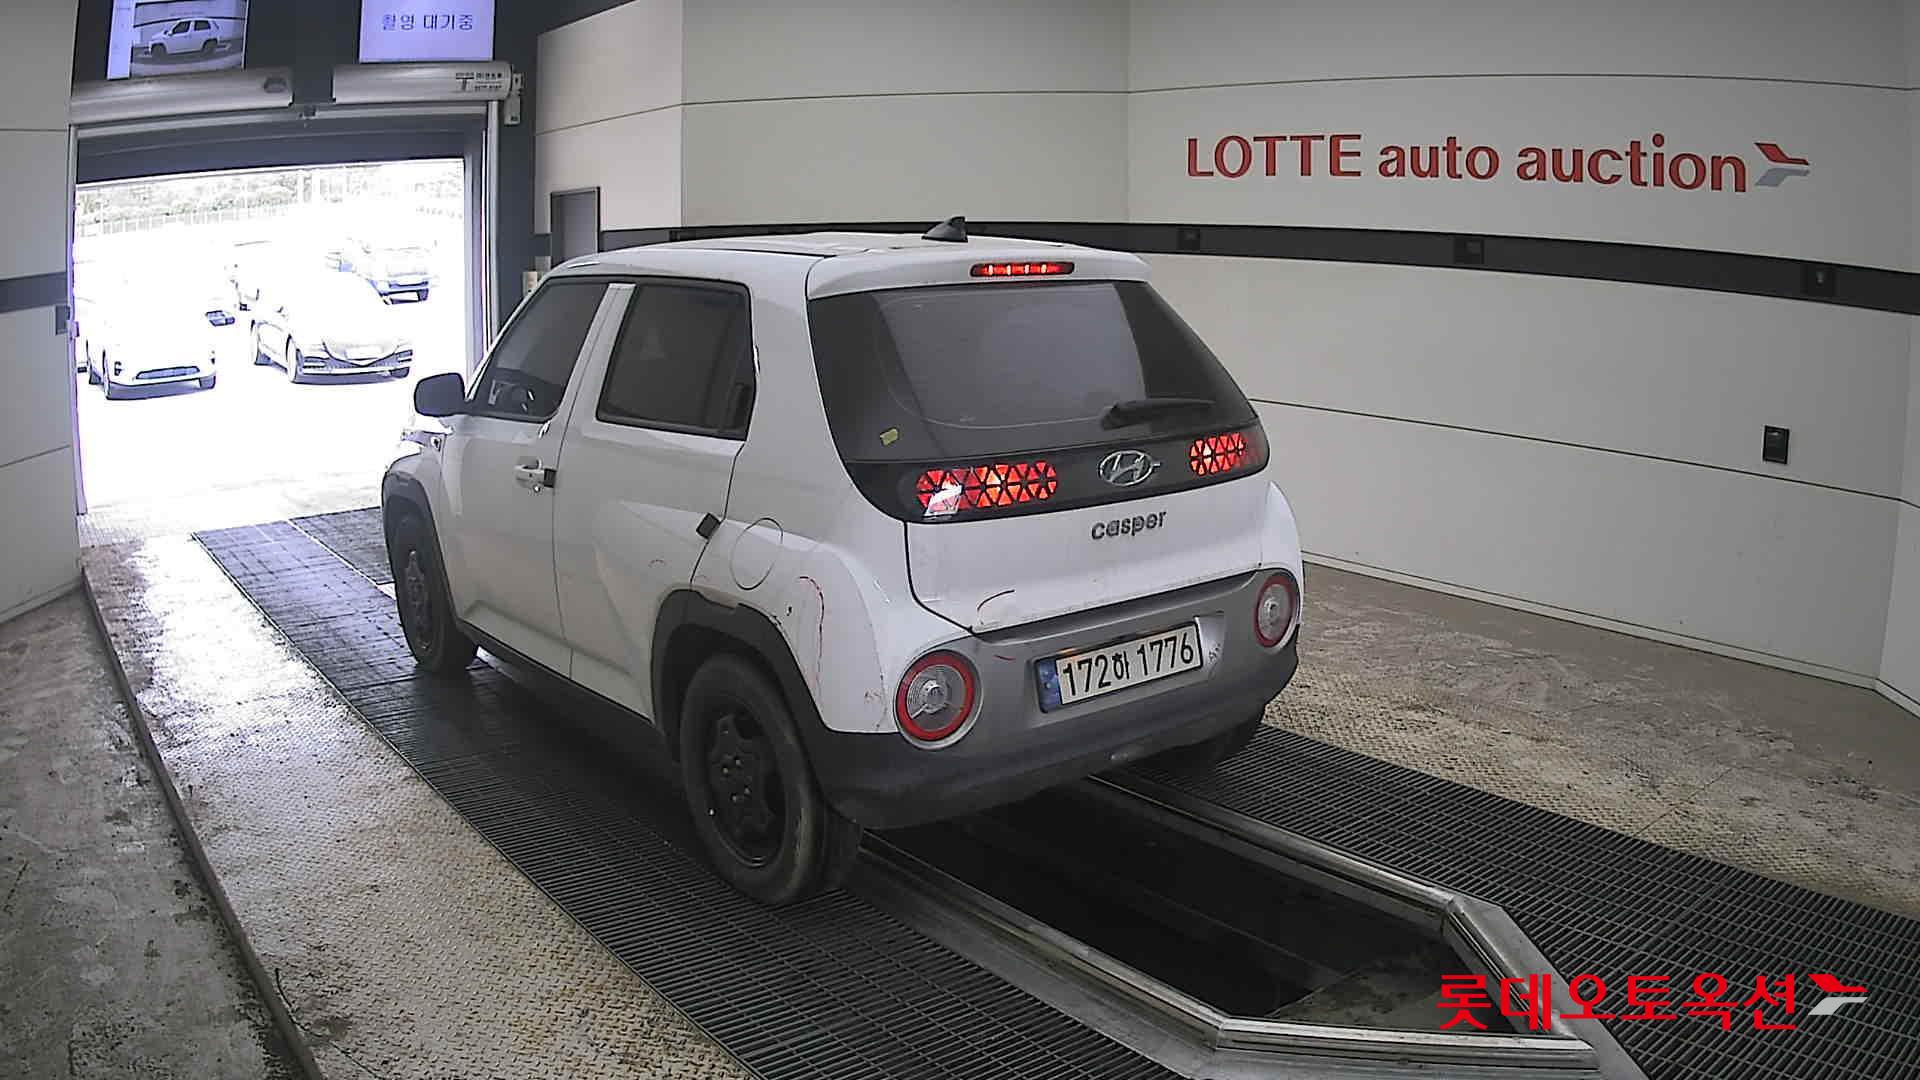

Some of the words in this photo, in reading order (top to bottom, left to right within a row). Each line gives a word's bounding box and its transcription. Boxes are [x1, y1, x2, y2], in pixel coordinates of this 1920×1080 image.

[423, 14, 473, 31] 대기중
[1187, 134, 1361, 178] LOTTE
[1378, 137, 1499, 180] auto
[1516, 134, 1746, 192] auction
[1091, 510, 1167, 540] casper
[1062, 650, 1130, 696] 172하
[1136, 632, 1195, 676] 1776
